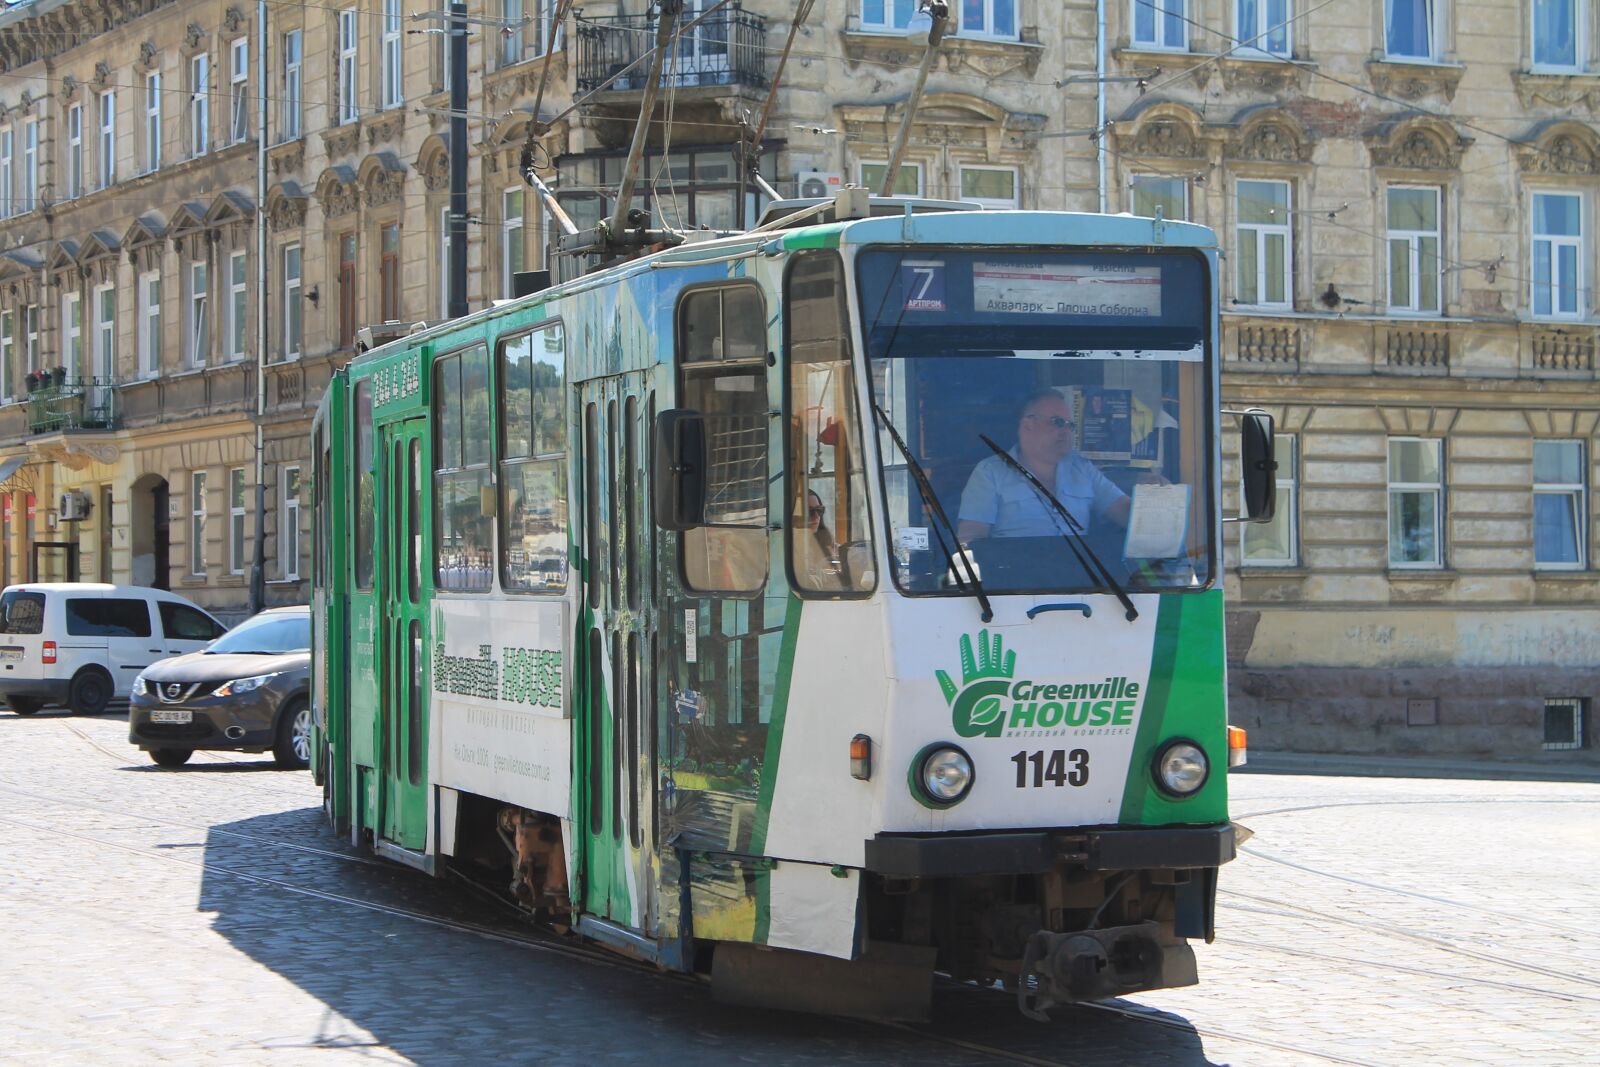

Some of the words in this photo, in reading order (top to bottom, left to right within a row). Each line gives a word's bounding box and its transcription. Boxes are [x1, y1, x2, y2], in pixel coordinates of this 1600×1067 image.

[913, 268, 934, 299] 7
[908, 299, 941, 308] АРТПРОМ
[986, 299, 1043, 312] Аквапарк
[1057, 302, 1097, 315] Площа
[1099, 303, 1149, 316] Соборна
[501, 647, 562, 708] HOUSE
[1012, 677, 1139, 701] Greenville
[1008, 701, 1137, 728] HOUSE
[1006, 728, 1066, 738] ЖИТЛОВИЙ
[1073, 728, 1132, 736] КОМПЛЕКС
[1011, 749, 1090, 788] 1143
